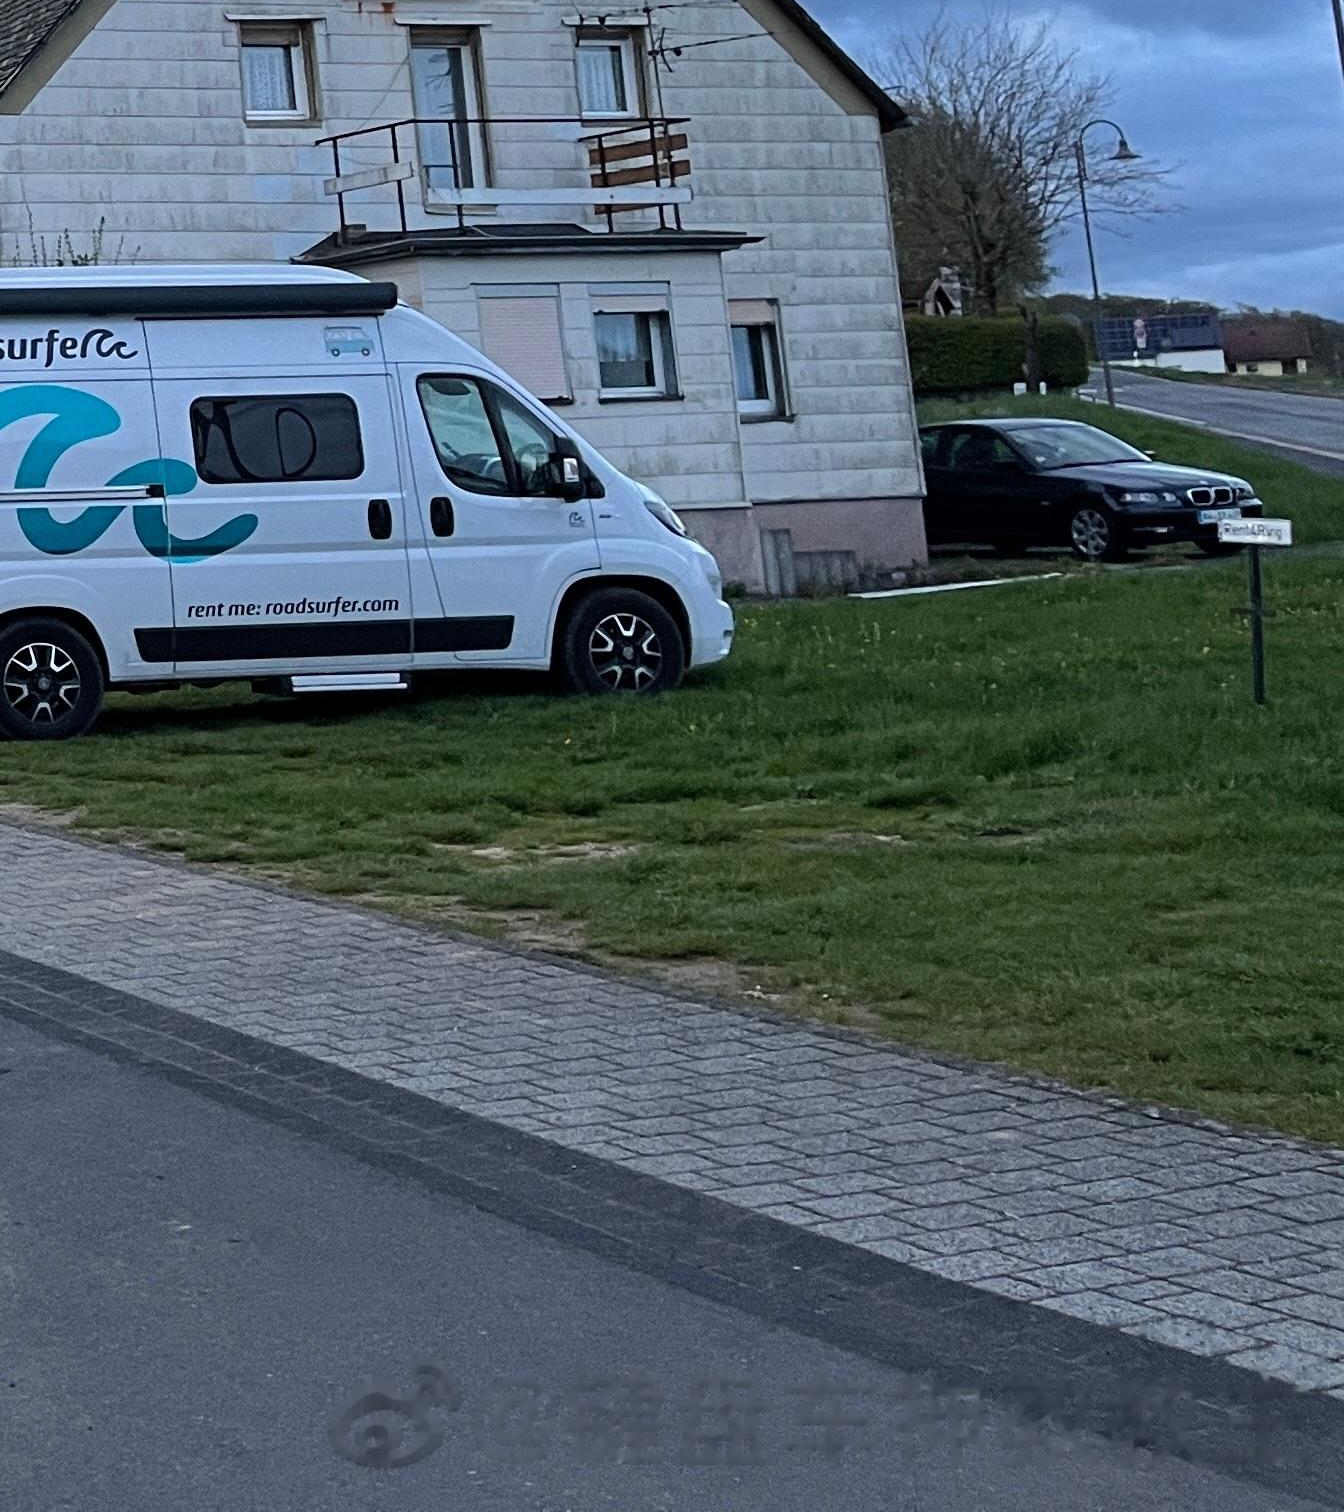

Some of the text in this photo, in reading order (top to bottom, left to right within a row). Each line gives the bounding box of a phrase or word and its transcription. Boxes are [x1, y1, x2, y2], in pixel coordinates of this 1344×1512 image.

[187, 596, 399, 618] rent me: roadsurfer.com
